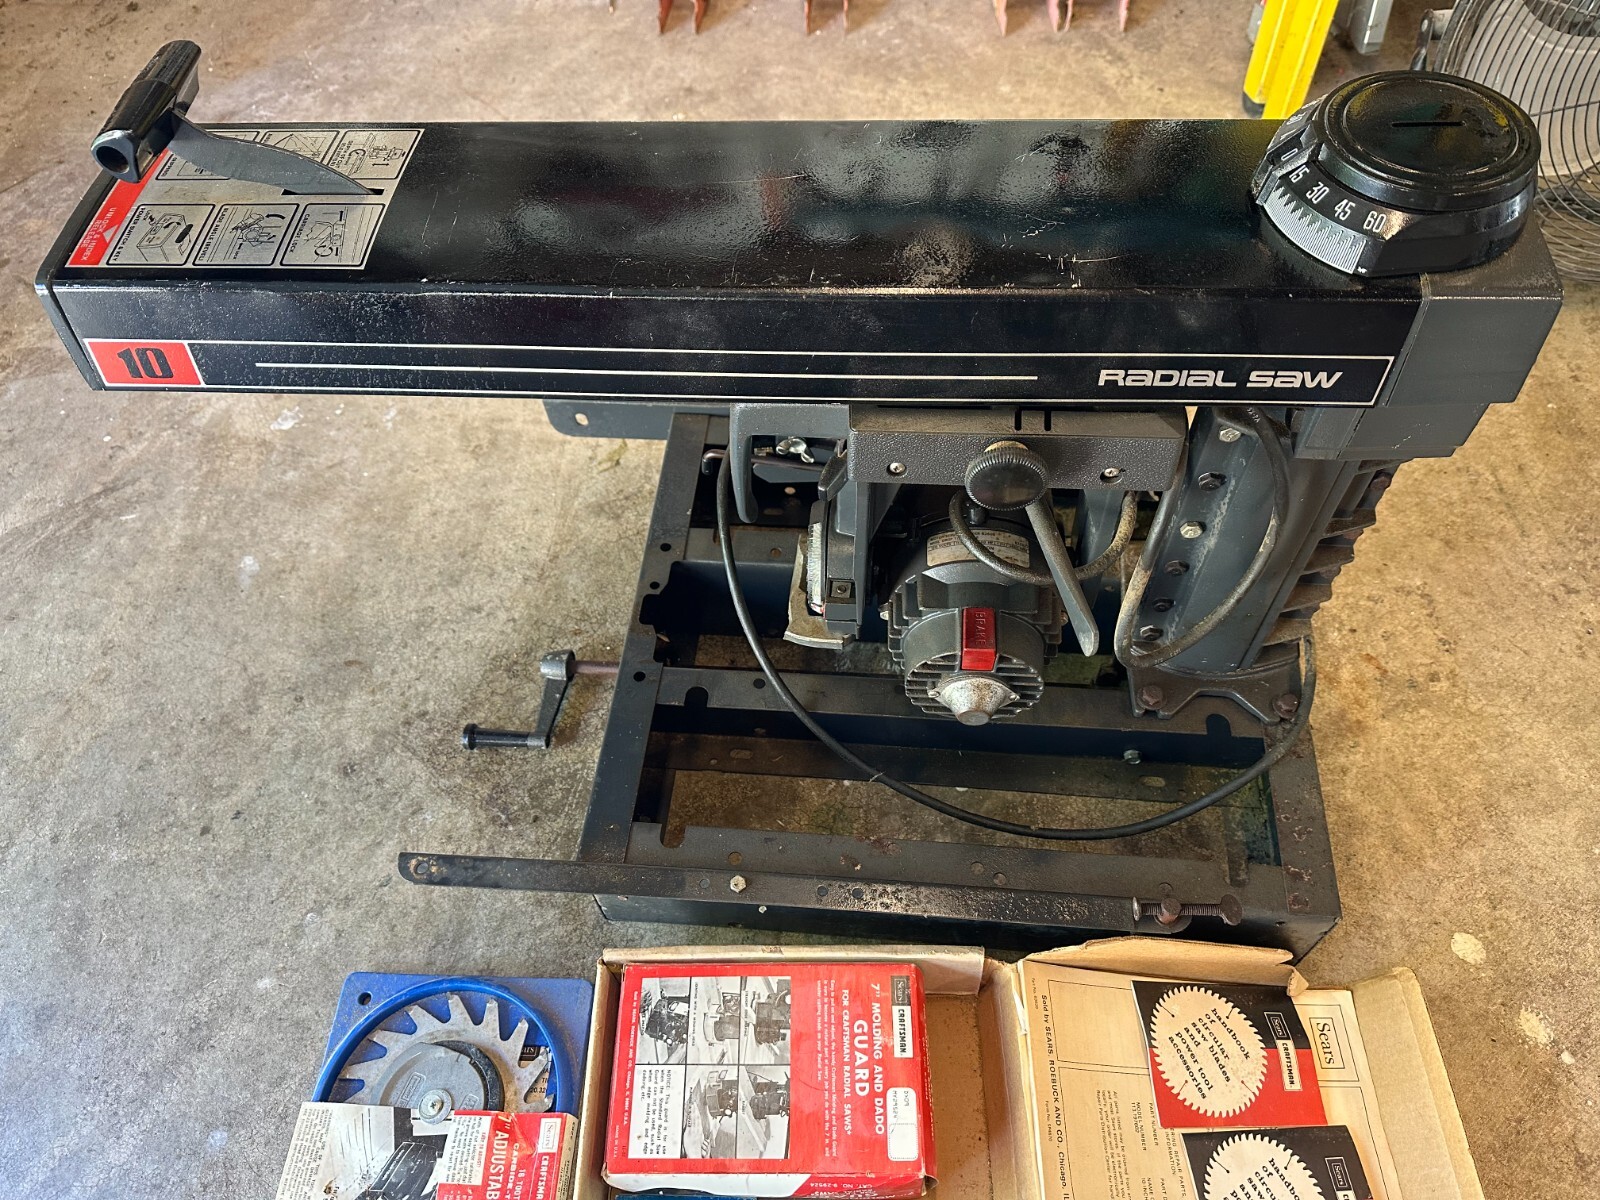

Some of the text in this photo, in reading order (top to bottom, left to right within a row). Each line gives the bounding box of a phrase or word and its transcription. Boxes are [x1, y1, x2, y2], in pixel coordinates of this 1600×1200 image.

[1288, 164, 1309, 184] 15
[1305, 182, 1329, 205] 30
[99, 207, 117, 233] UNLOCK
[134, 207, 146, 225] POWER
[1334, 198, 1356, 221] 45
[1363, 210, 1387, 233] 60
[80, 219, 101, 248] RELEASE
[122, 225, 136, 246] SWITCH
[81, 240, 97, 261] INDEX
[112, 251, 121, 262] KEY
[289, 240, 299, 254] LOCK
[116, 346, 174, 380] 10
[974, 611, 986, 647] BRAKE
[842, 989, 850, 1007] FOR
[896, 980, 905, 1002] Sears
[1041, 993, 1051, 1012] Sold
[872, 1002, 883, 1060] MOLDING
[1043, 1013, 1051, 1024] by
[1205, 1013, 1216, 1025] of
[842, 1009, 851, 1062] CRAFTSMAN
[1045, 1025, 1055, 1057] SEARS,
[1184, 1026, 1201, 1048] and
[1198, 1017, 1230, 1061] circular
[1210, 1007, 1252, 1061] handbook
[1315, 1022, 1336, 1066] Sears
[853, 1019, 870, 1097] GUARD
[1175, 1031, 1214, 1092] power tool
[1191, 1021, 1232, 1084] saw blades
[1272, 1018, 1295, 1086] Sears CRAFTSMAN
[874, 1065, 884, 1094] AND
[1168, 1036, 1207, 1100] accessories
[843, 1066, 852, 1099] RADIAL
[1048, 1059, 1061, 1104] ROEBUCK
[875, 1097, 886, 1136] DADO
[1054, 1105, 1062, 1127] AND
[544, 1123, 554, 1148] Sears
[1056, 1129, 1064, 1149] CO.,
[1139, 1124, 1147, 1151] NUMBER
[1151, 1120, 1159, 1147] NUMBER
[1164, 1131, 1177, 1175] INFORMATION
[1174, 1150, 1183, 1173] REPAIR
[1058, 1151, 1068, 1190] Chicago,
[1262, 1165, 1274, 1178] of
[1333, 1164, 1347, 1187] Sears
